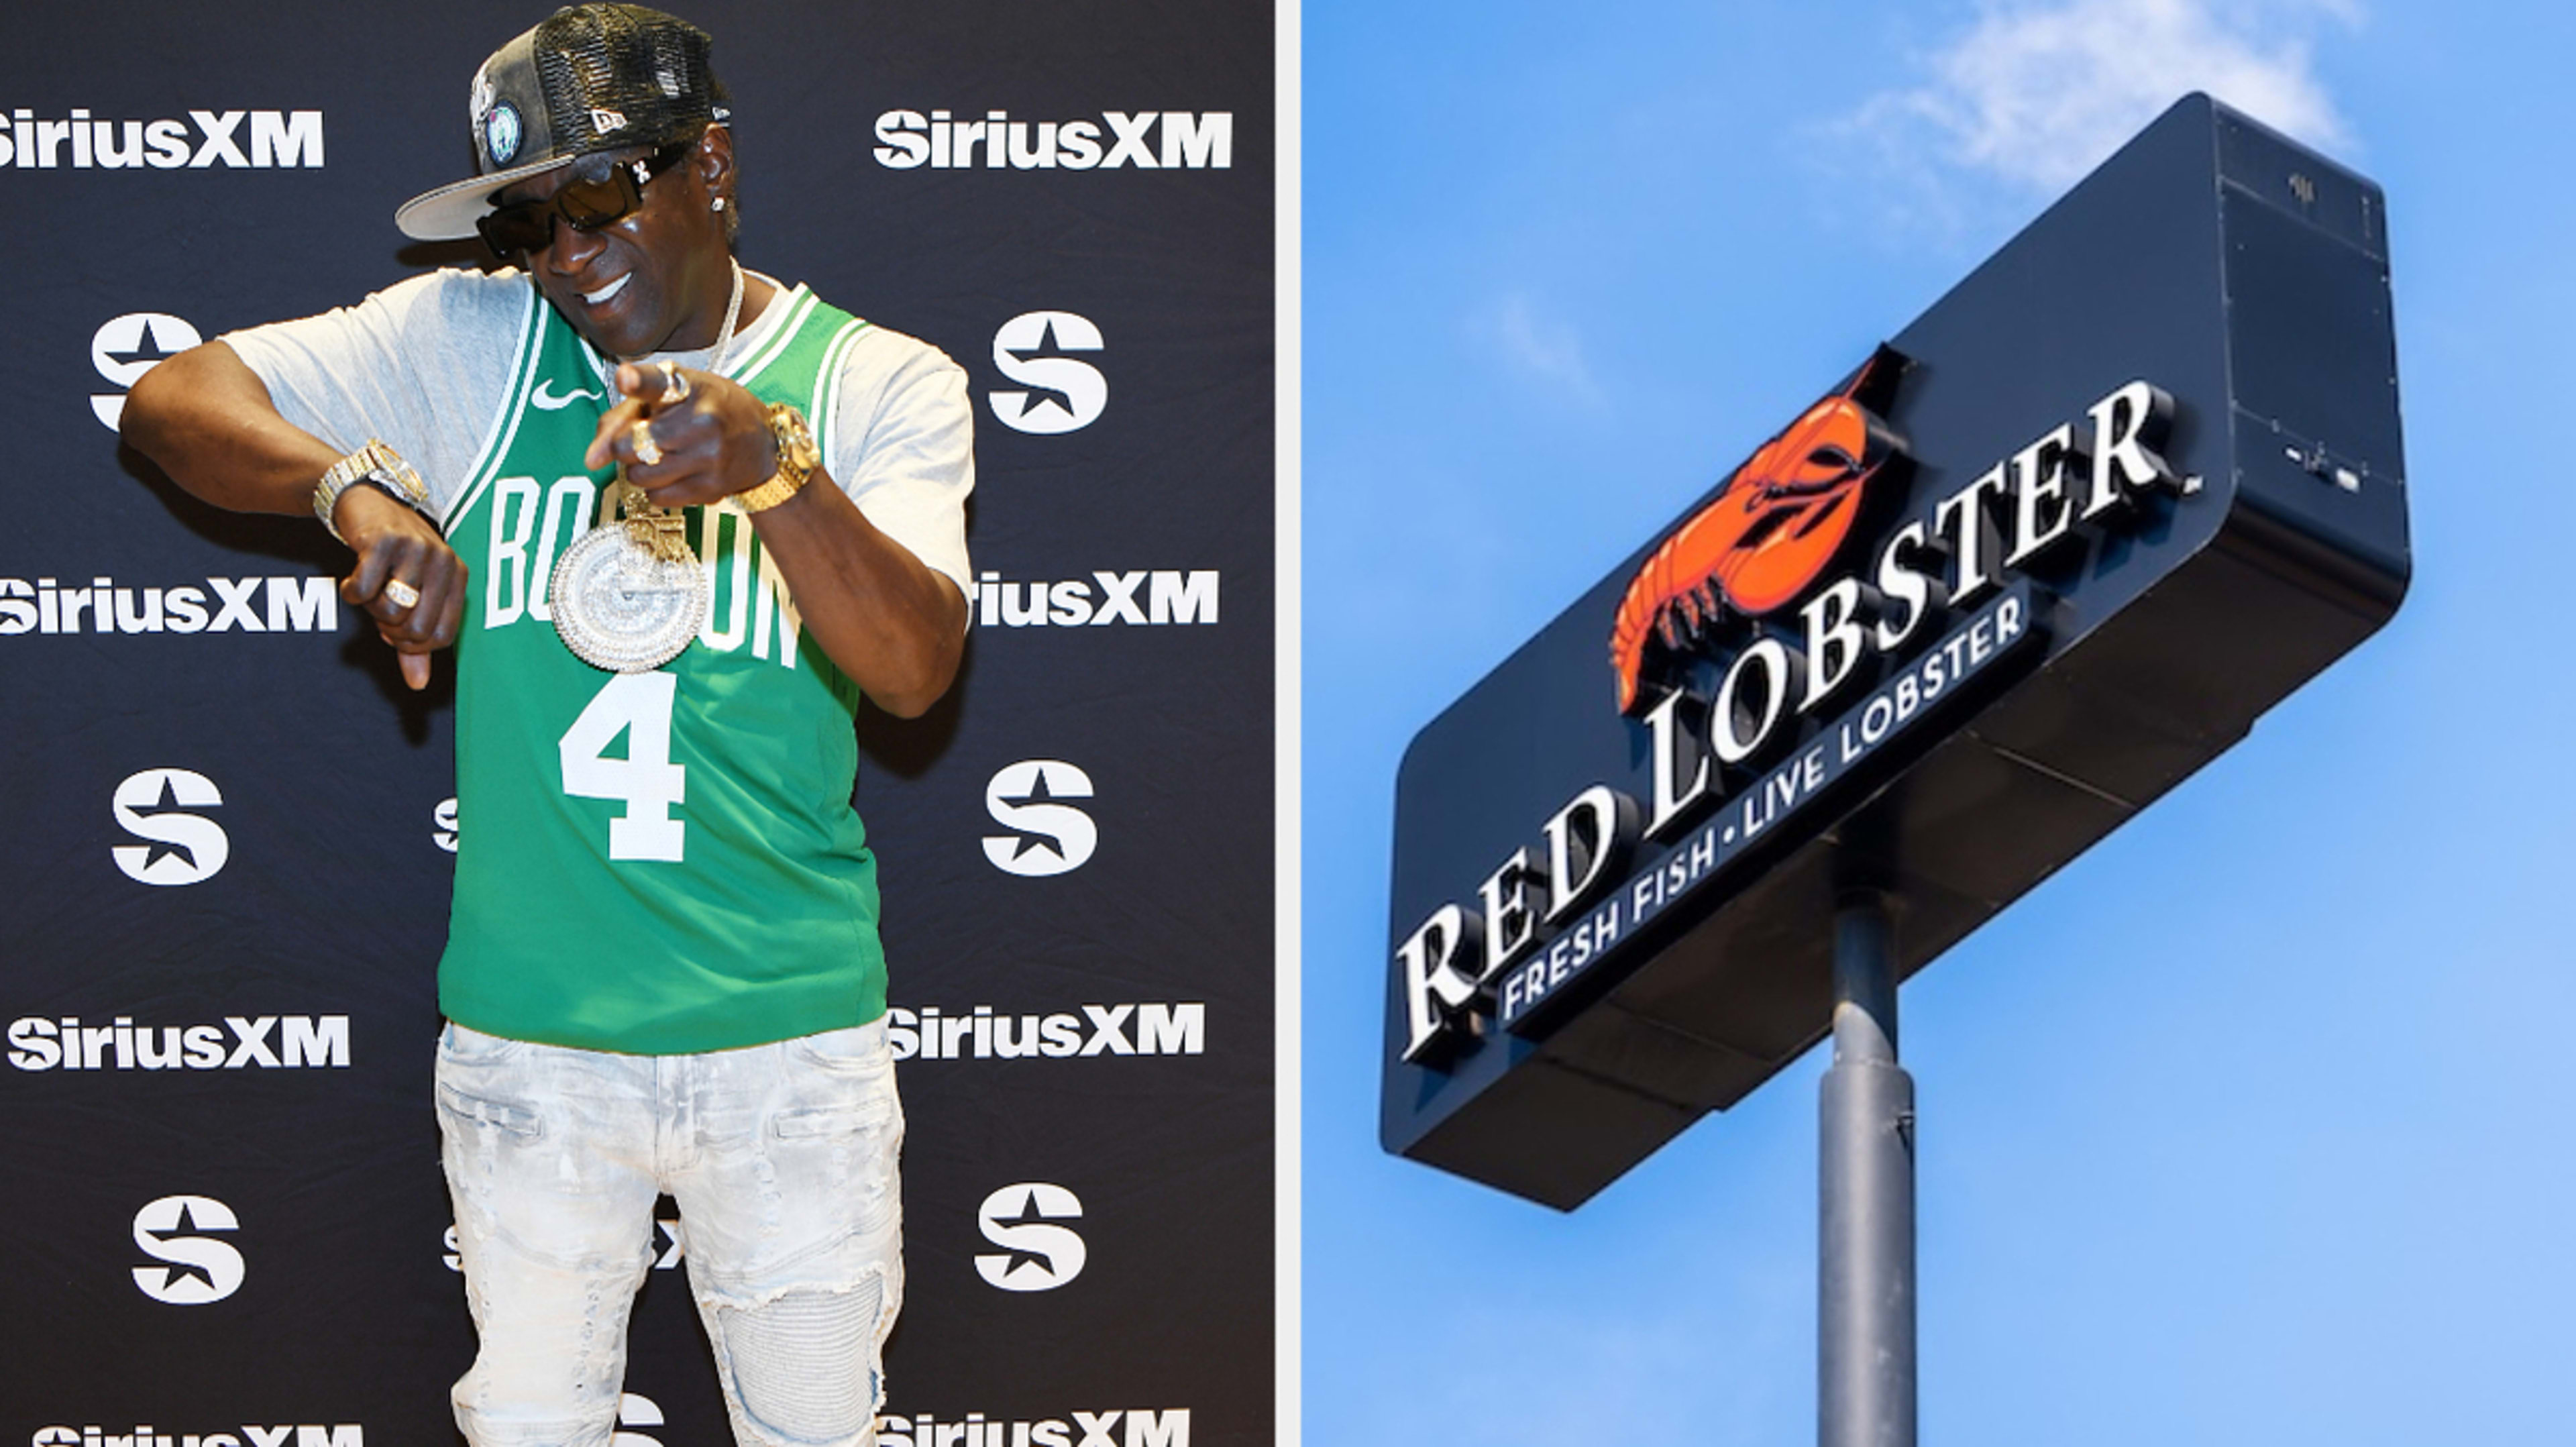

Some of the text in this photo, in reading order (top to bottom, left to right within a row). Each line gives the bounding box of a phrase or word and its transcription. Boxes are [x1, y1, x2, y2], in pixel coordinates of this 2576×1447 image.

[0, 109, 323, 168] iriusXM
[873, 110, 1233, 169] SiriusXM
[989, 311, 1108, 434] S
[484, 476, 802, 670] BOON
[971, 570, 1220, 627] iusXM
[558, 670, 686, 862] 4
[1397, 380, 2157, 1061] RED LOBSTER
[111, 768, 229, 886] S
[981, 760, 1098, 877] S
[1504, 596, 2021, 1020] FRESH FISH LIVE LOBSTER
[7, 1015, 350, 1070] SiriusXM
[132, 1195, 246, 1304] S
[974, 1182, 1087, 1291] S
